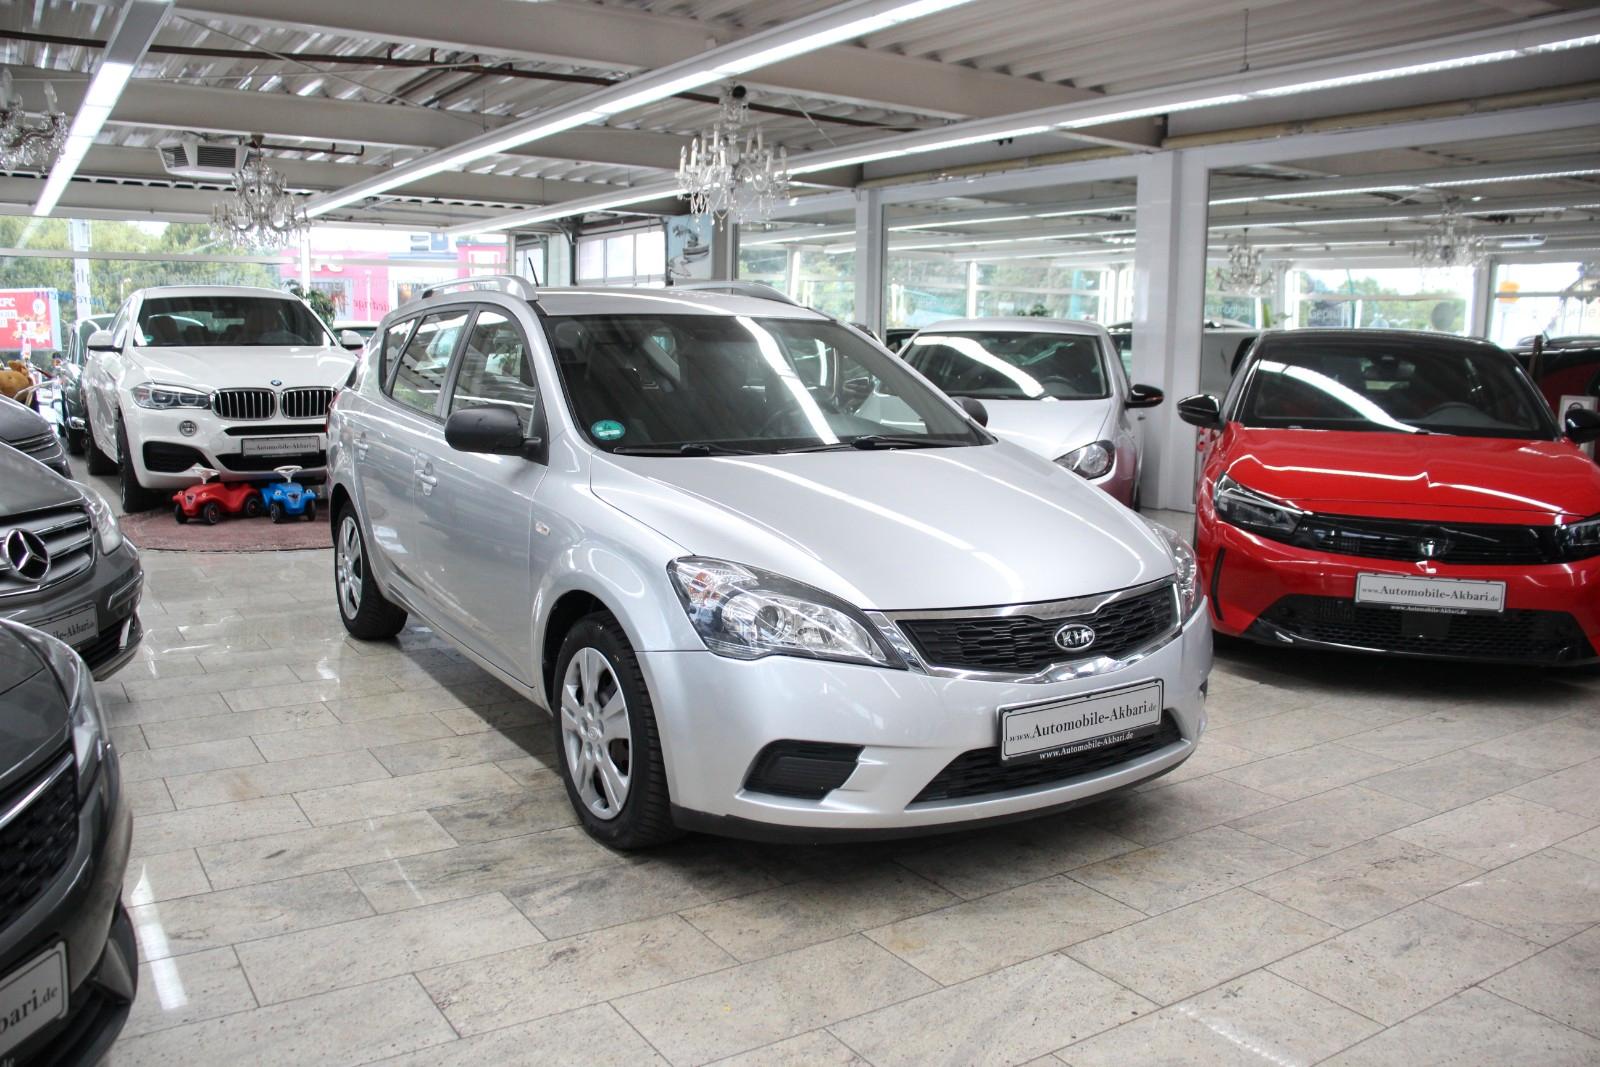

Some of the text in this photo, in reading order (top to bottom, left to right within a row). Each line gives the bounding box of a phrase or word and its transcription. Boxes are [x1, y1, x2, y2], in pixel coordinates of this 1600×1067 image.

[1362, 585, 1500, 603] www.Automobile-Akbari.de
[1008, 700, 1157, 743] www.Automobile-Akbari.de
[1039, 731, 1134, 760] www.Automobile-Akbari.de
